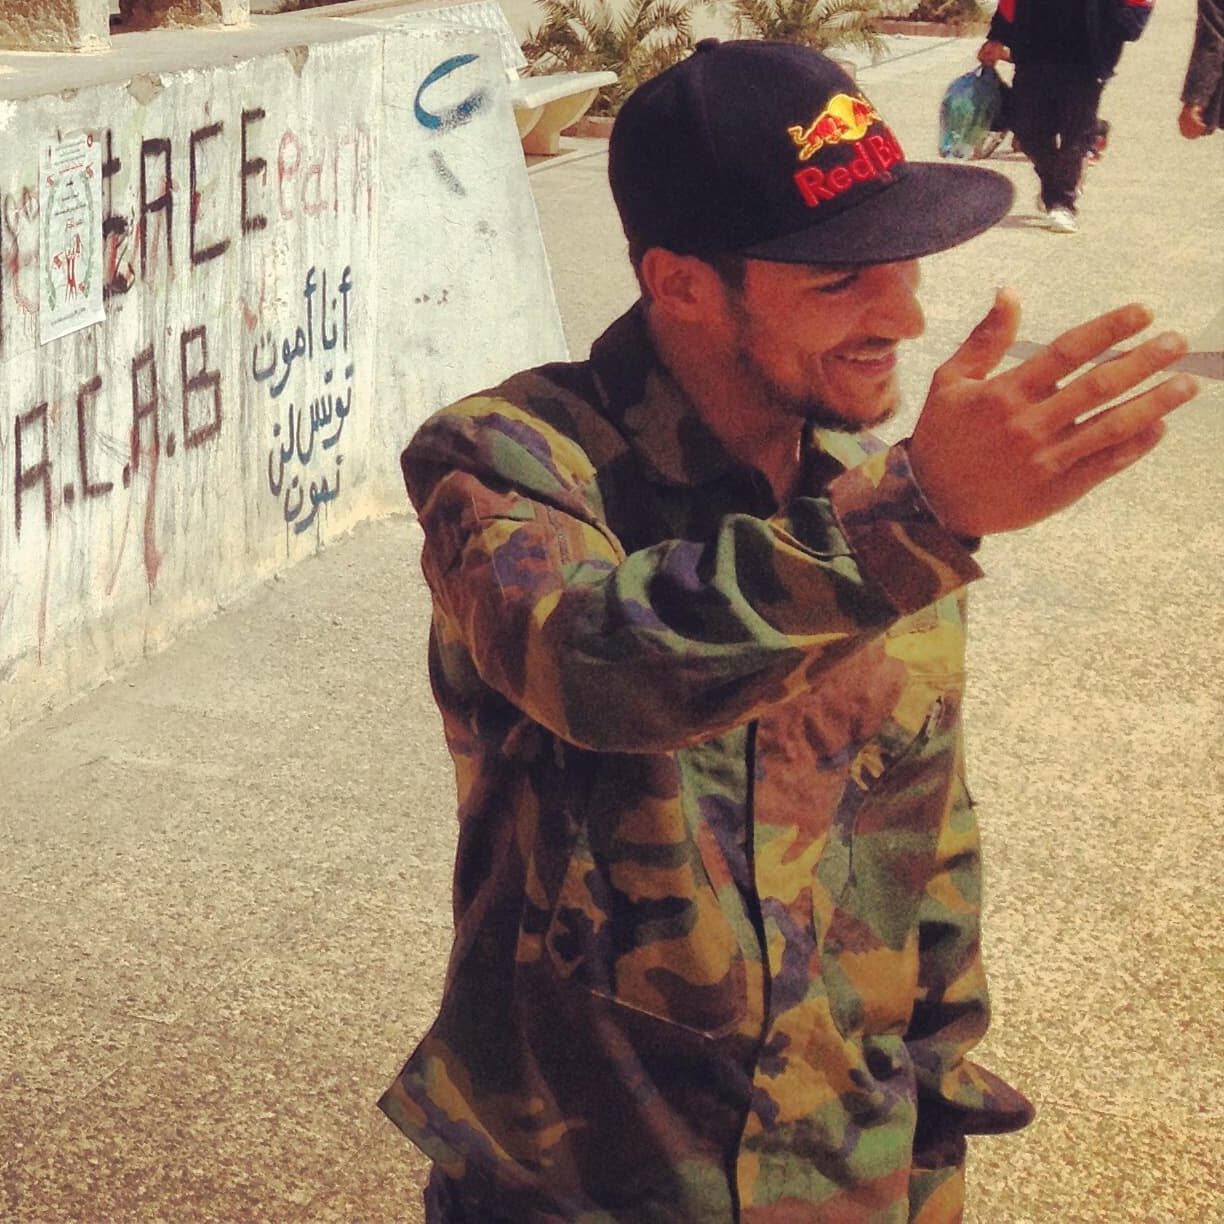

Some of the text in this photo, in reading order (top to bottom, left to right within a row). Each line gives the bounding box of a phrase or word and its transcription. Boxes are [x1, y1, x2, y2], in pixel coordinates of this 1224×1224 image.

[793, 138, 878, 208] Red
[251, 265, 353, 397] أنا أموت
[295, 362, 355, 466] تونس
